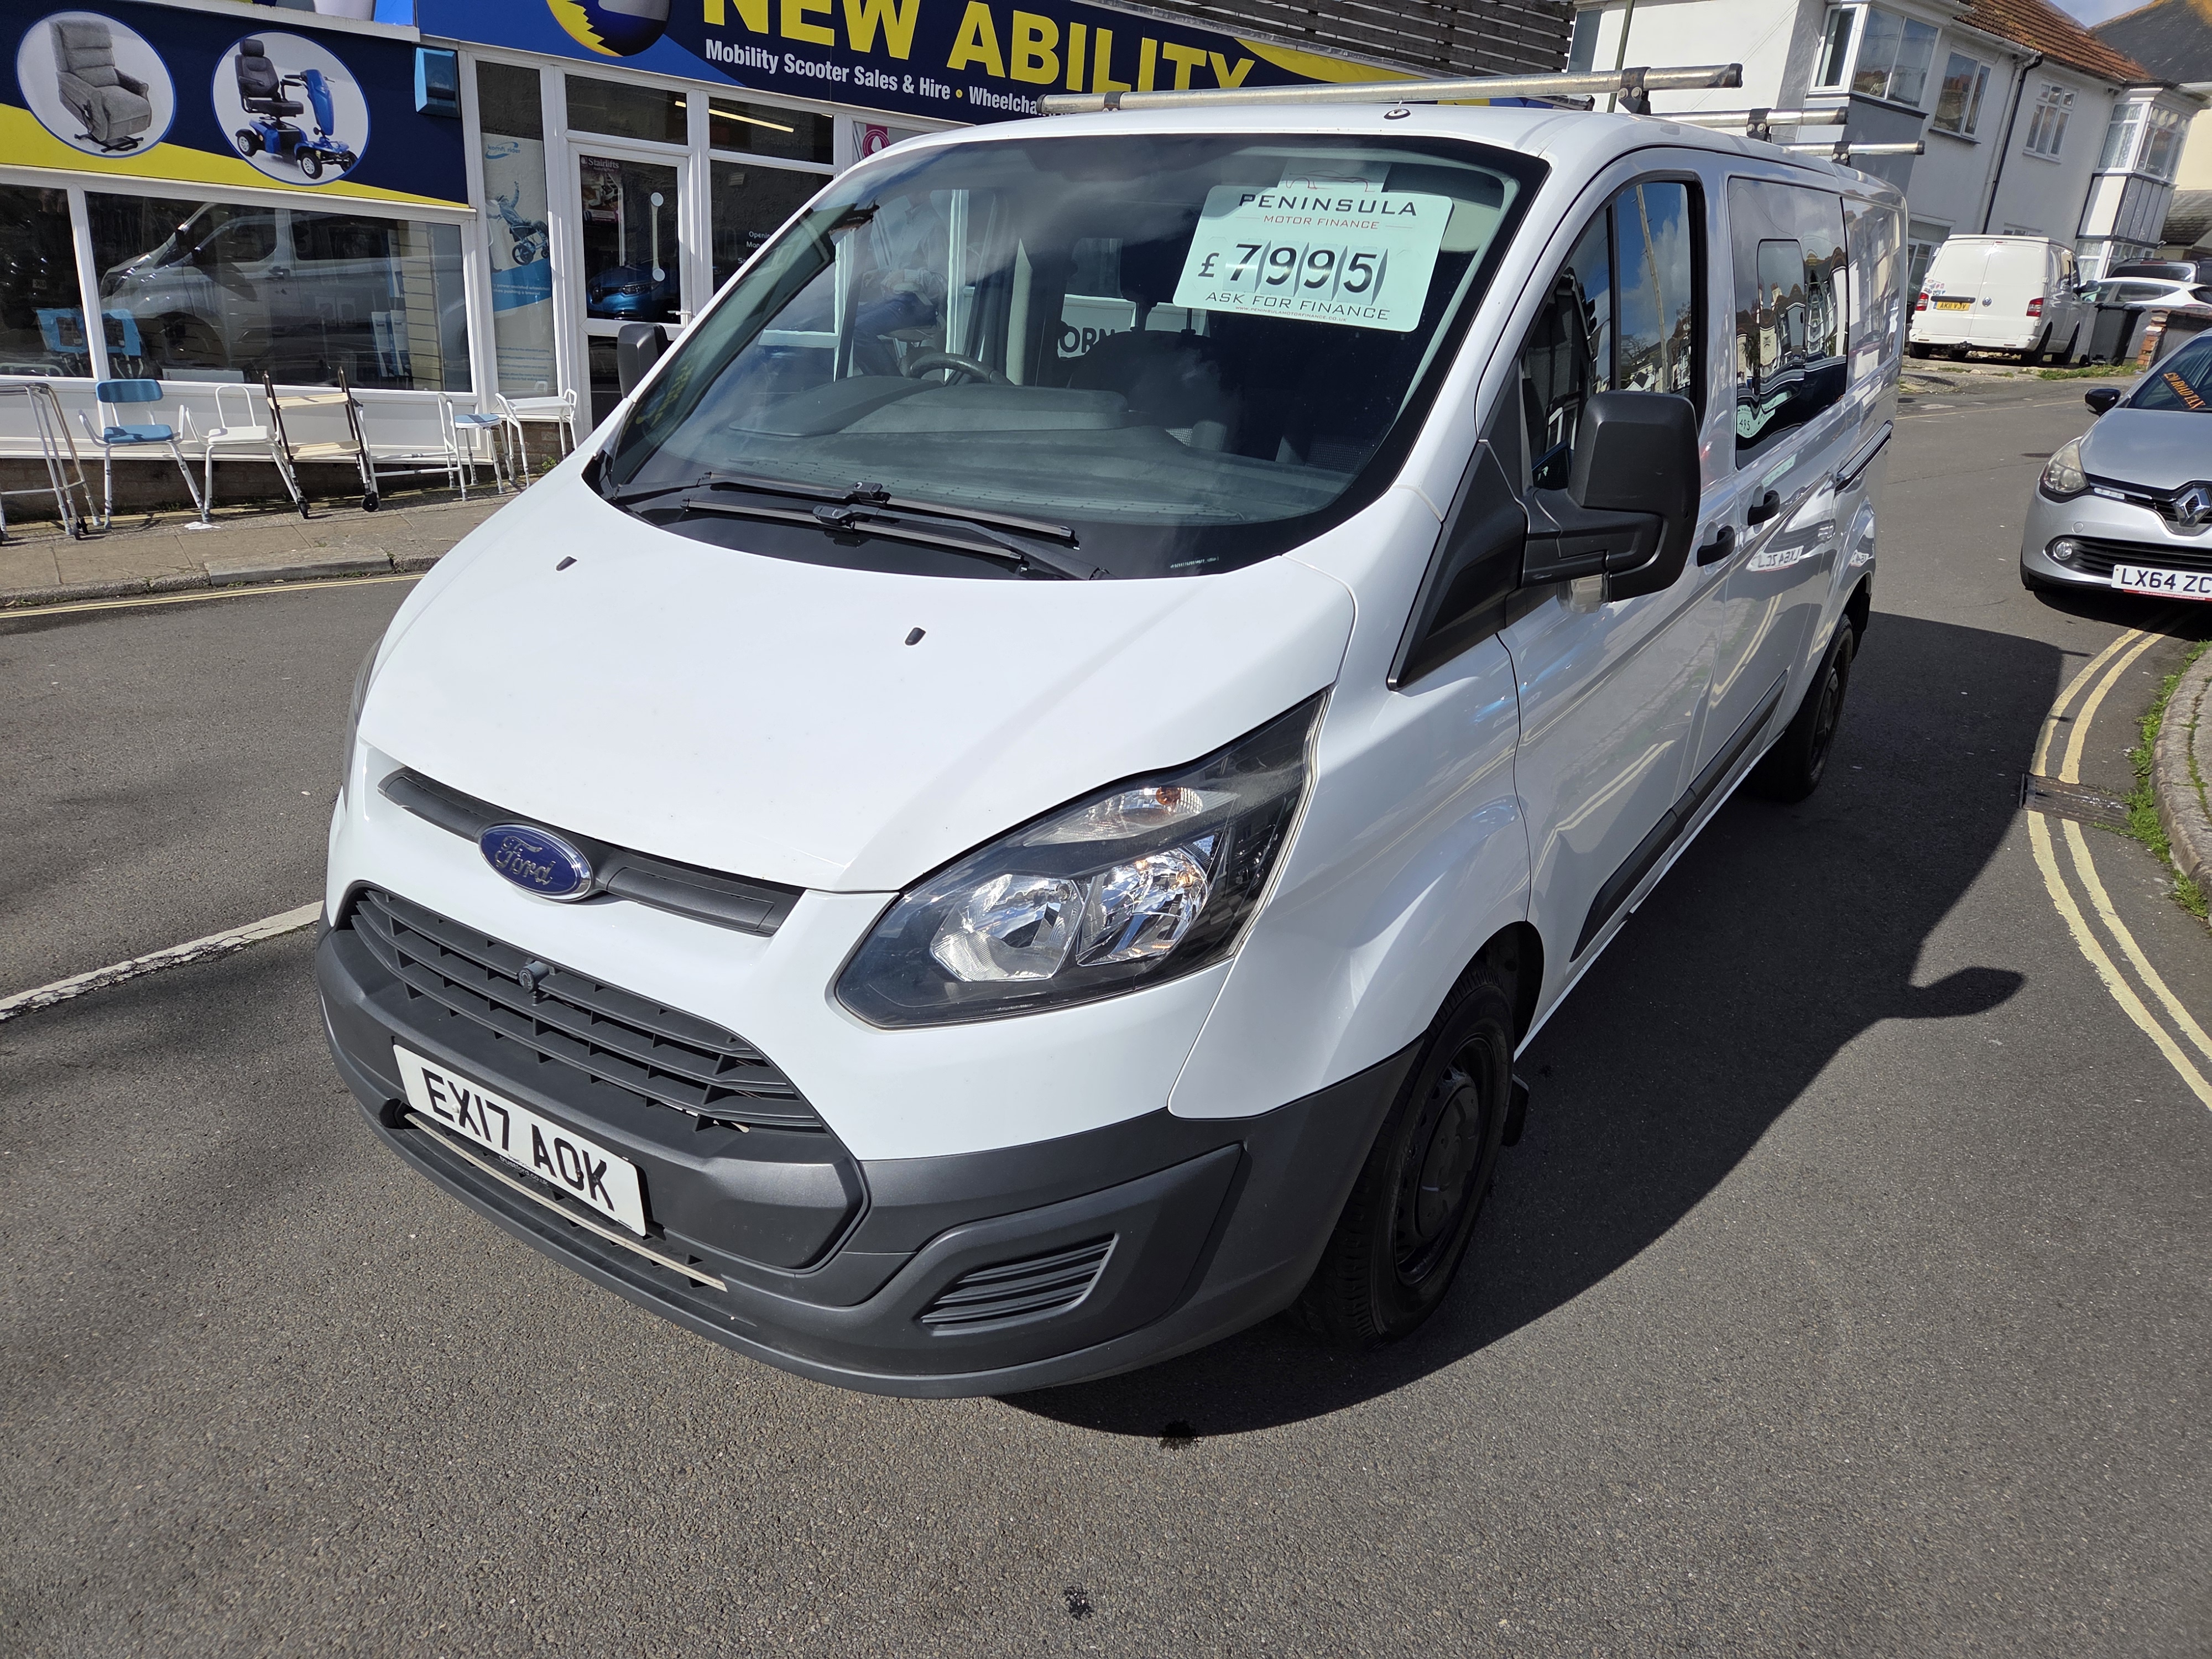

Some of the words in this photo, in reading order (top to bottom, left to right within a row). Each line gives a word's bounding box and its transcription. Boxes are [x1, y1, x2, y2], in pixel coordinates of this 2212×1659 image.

[706, 39, 779, 74] Mobility
[784, 53, 849, 82] Scooter
[854, 66, 898, 91] Sales
[902, 75, 915, 94] &
[919, 77, 951, 100] Hire
[969, 86, 1047, 117] Wheelcha
[588, 157, 619, 169] Stairlifts
[1239, 194, 1417, 216] PENINSULA
[1263, 215, 1312, 225] MOTOR
[1317, 217, 1380, 229] FINANCE
[1229, 243, 1378, 293] 7995
[1206, 292, 1245, 304] ASK
[1252, 296, 1292, 309] FOR
[1300, 300, 1390, 320] FINANCE
[1235, 306, 1347, 322] WWW.PENINSULAMOTORFINANCE.CO.UK
[2121, 568, 2176, 590] LX64
[2183, 575, 2212, 593] ZC
[494, 836, 556, 885] Ford
[421, 1067, 510, 1152] EX17
